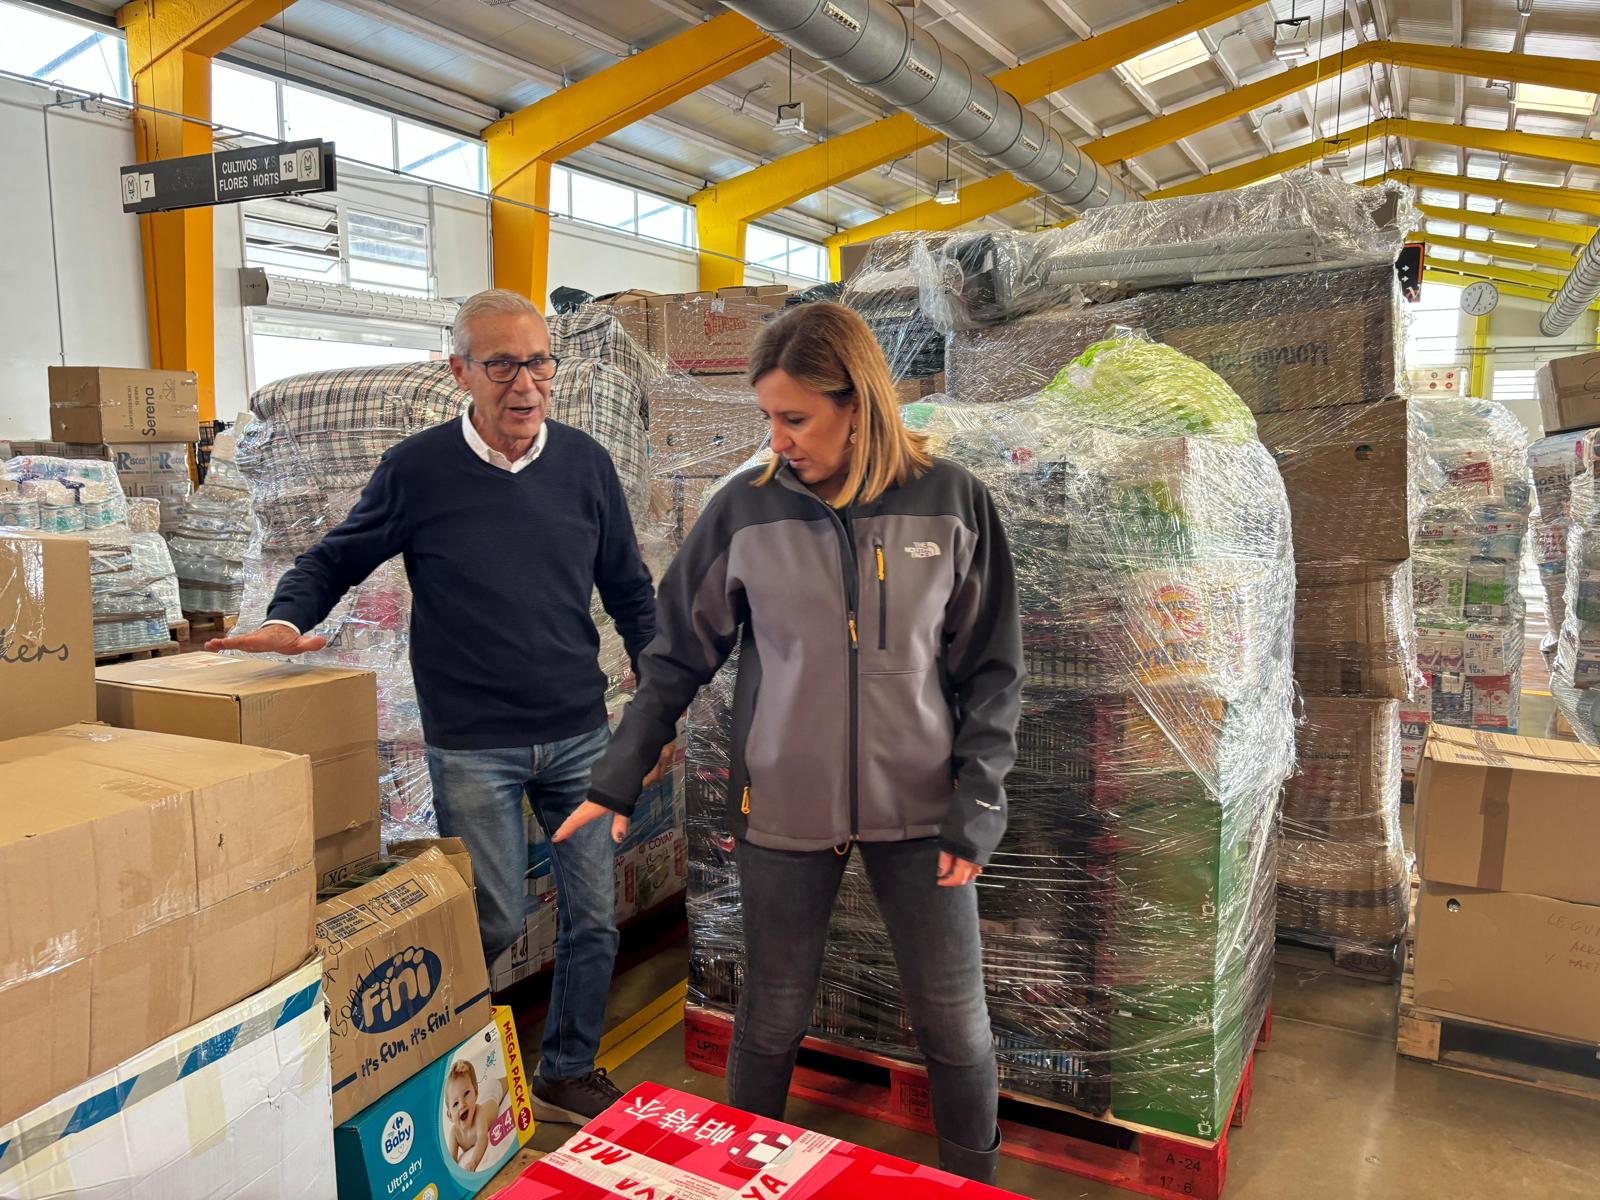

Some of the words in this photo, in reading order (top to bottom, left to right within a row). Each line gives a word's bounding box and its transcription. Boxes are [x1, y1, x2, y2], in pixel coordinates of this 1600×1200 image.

[222, 159, 257, 173] CULTIVOS
[263, 157, 270, 168] Y
[282, 160, 294, 173] 18
[144, 180, 150, 192] 7
[219, 174, 249, 191] FLORES
[252, 172, 280, 187] HORTS
[142, 387, 156, 437] Serena
[1546, 913, 1600, 936] LEGU
[361, 1057, 380, 1078] it's
[410, 1028, 427, 1046] it's
[503, 1020, 517, 1065] MEGA
[512, 1066, 525, 1108] PACK
[503, 1110, 512, 1124] 4
[624, 1096, 737, 1147] 帕特尔
[384, 1125, 411, 1154] Baby
[569, 1136, 632, 1165] MA
[387, 1171, 409, 1194] Ultra
[408, 1157, 422, 1175] dry
[742, 1173, 788, 1200] YA
